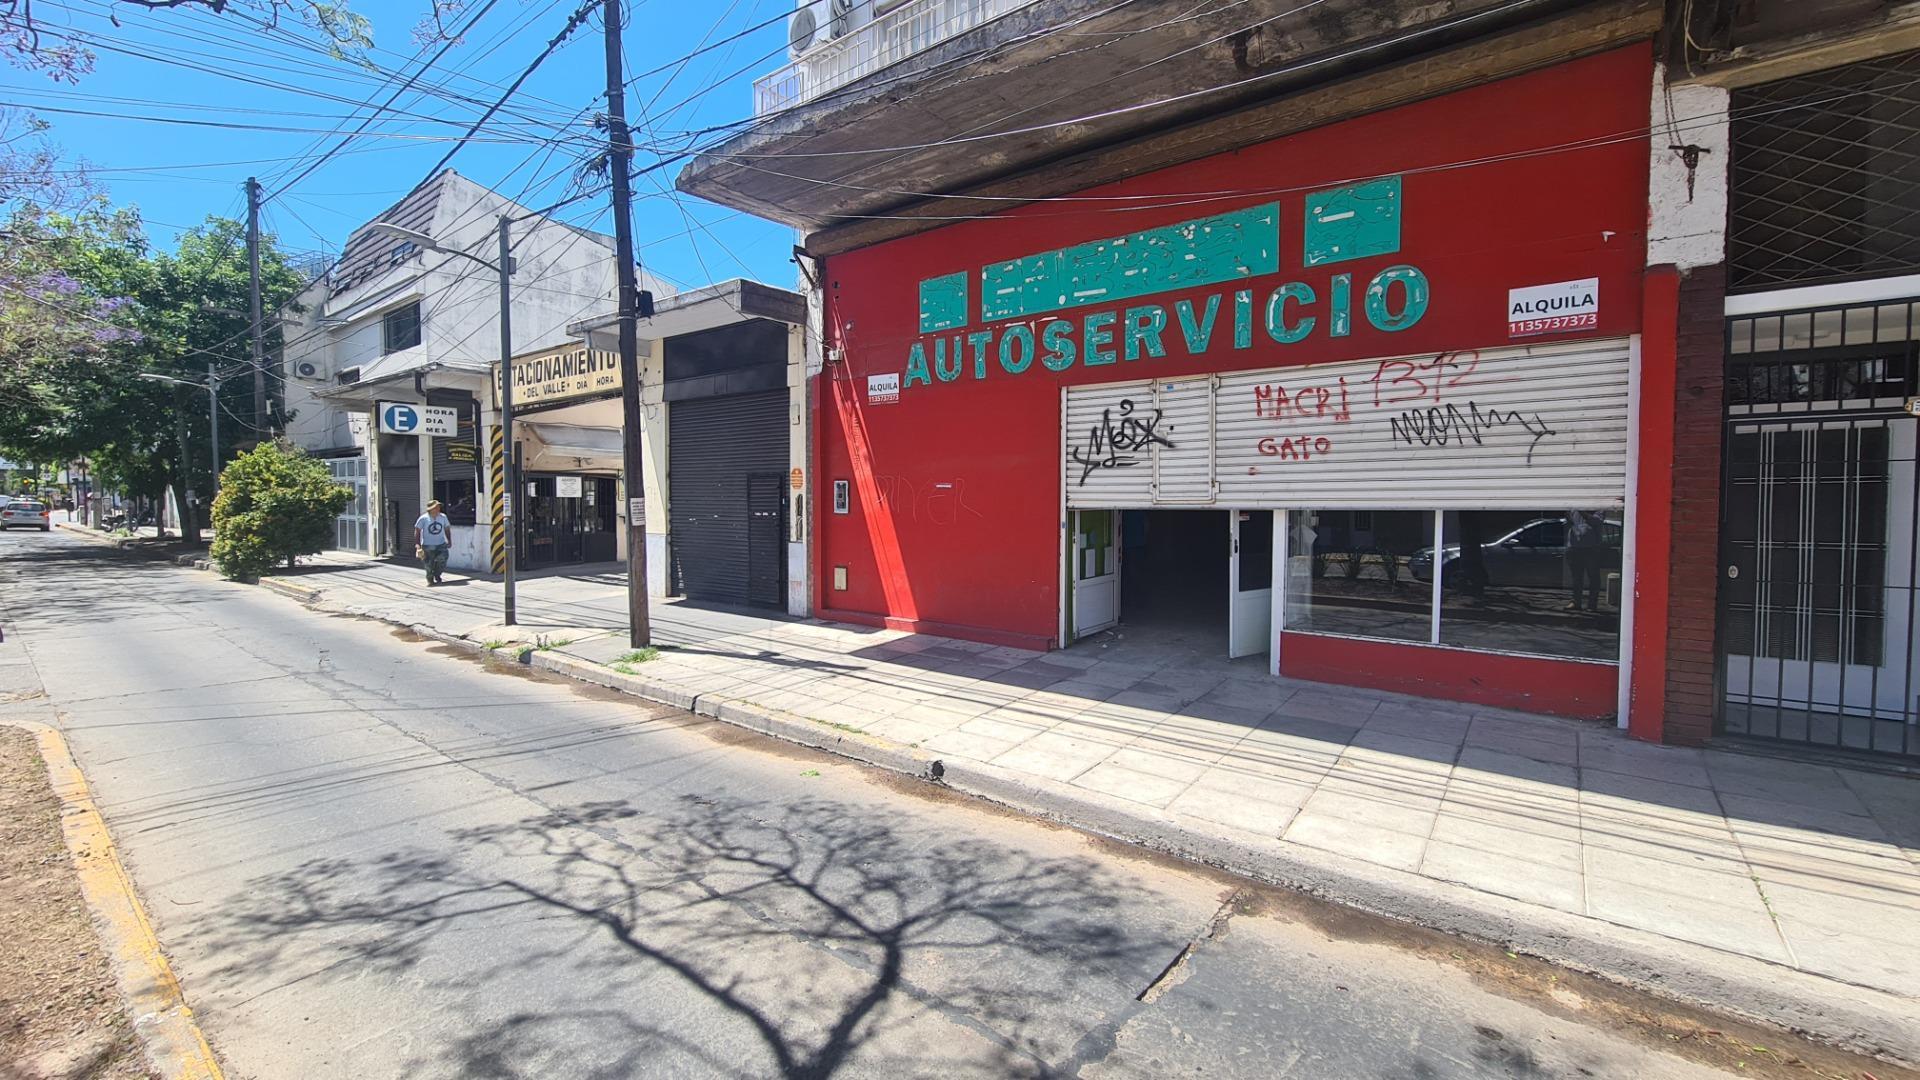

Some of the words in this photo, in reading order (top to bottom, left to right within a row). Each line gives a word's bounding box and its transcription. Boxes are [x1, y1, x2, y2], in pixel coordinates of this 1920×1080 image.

[1512, 293, 1595, 315] ALQUILA
[903, 265, 1430, 388] AUTOSERVICIO
[1509, 313, 1597, 333] 1135737373
[497, 348, 616, 390] ETACIONAMIENTO
[526, 387, 539, 398] DEL
[543, 381, 566, 395] VALLE
[596, 376, 614, 386] HORA
[869, 382, 898, 392] ALQUILA
[393, 407, 409, 431] E
[1258, 437, 1331, 460] GATO
